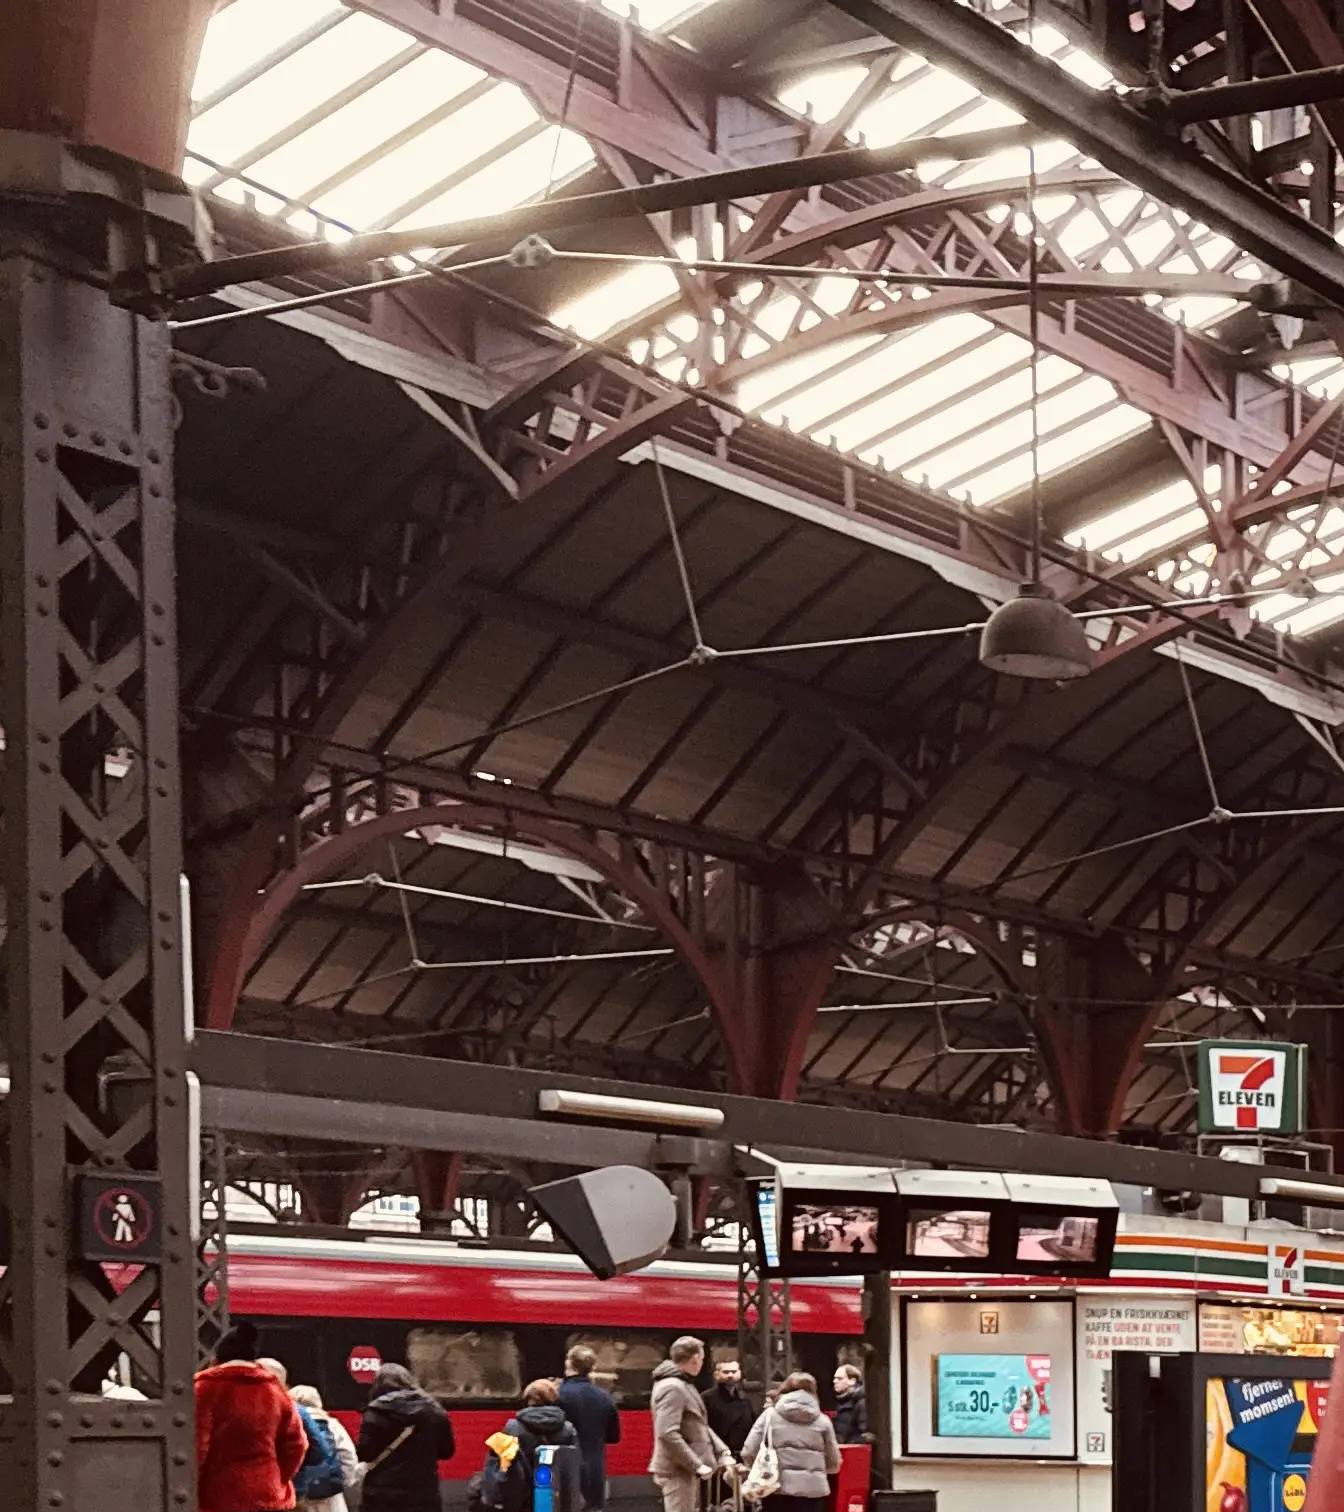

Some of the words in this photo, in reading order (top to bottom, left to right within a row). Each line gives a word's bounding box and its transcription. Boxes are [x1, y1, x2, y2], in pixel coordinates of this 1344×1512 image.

[1219, 1055, 1275, 1129] 7
[1110, 1307, 1122, 1319] EN
[350, 1356, 380, 1372] DSB
[970, 1390, 999, 1415] 30,-
[1239, 1387, 1296, 1424] momsen!
